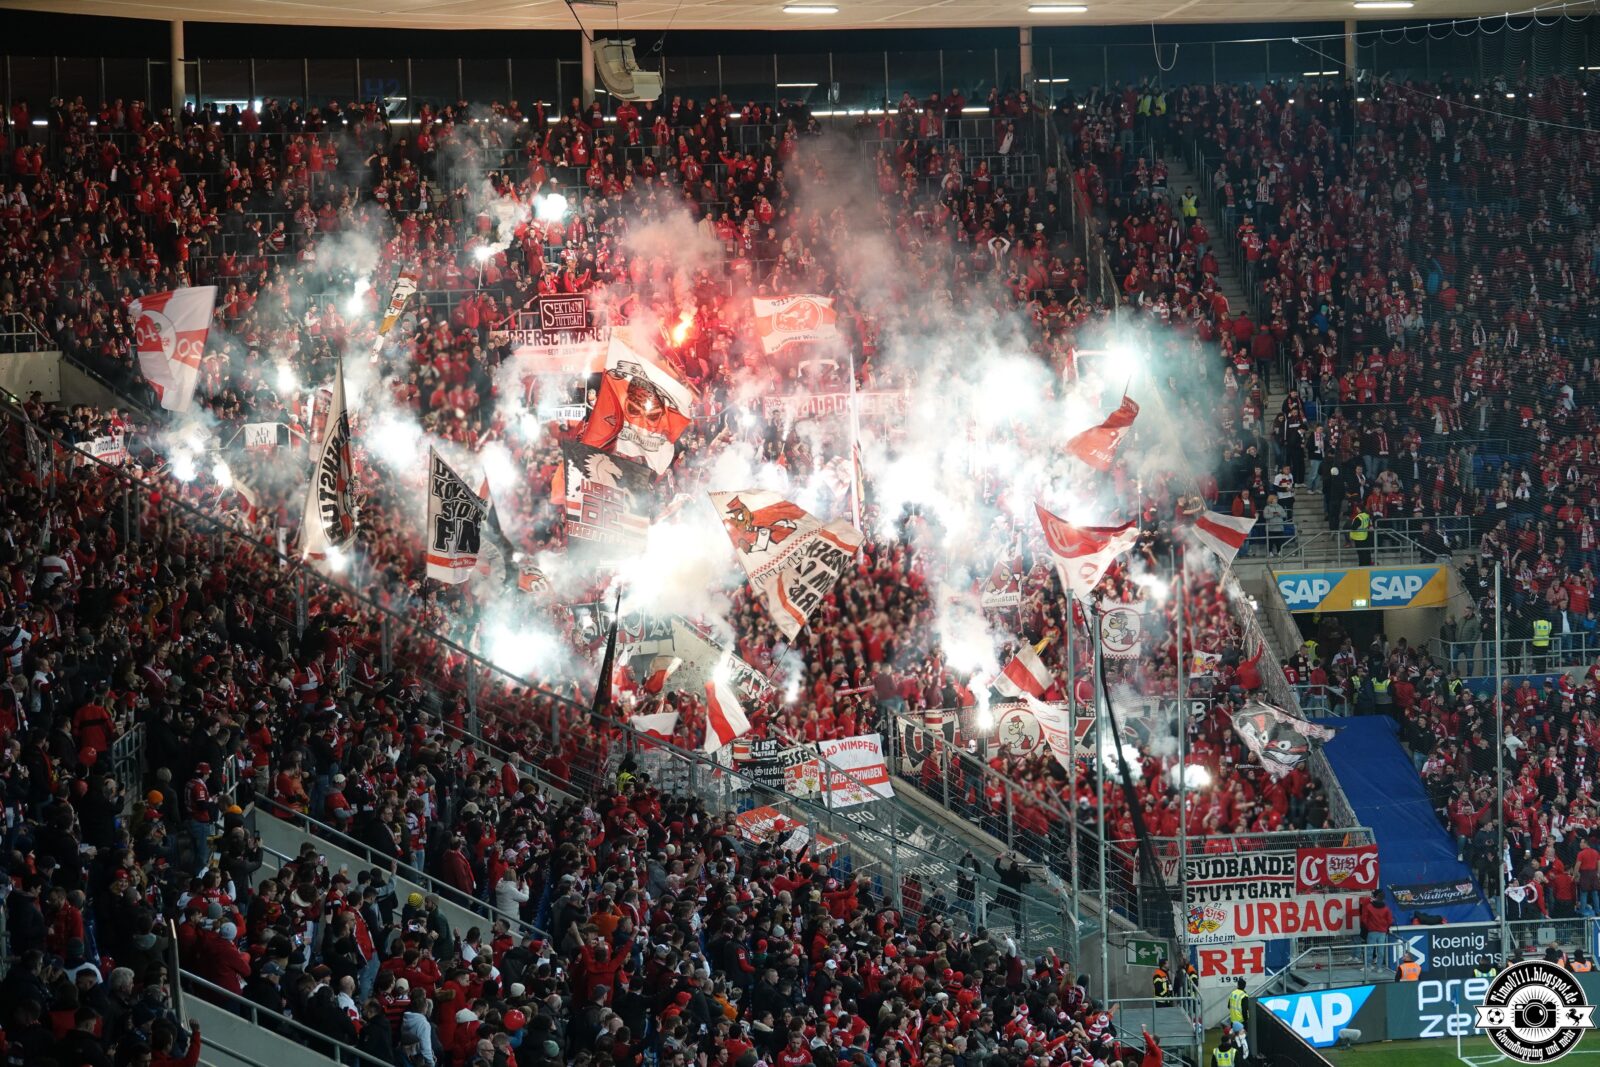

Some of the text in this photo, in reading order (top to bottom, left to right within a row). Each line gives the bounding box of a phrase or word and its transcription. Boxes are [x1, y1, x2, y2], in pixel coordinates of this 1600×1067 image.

[1279, 575, 1423, 604] SAP SAP
[821, 740, 878, 759] BAD WIMPFEN
[1186, 854, 1296, 880] SÜDBANDE
[1186, 882, 1295, 903] STUTTGART
[1234, 896, 1363, 938] URBACH
[1199, 946, 1264, 977] RH
